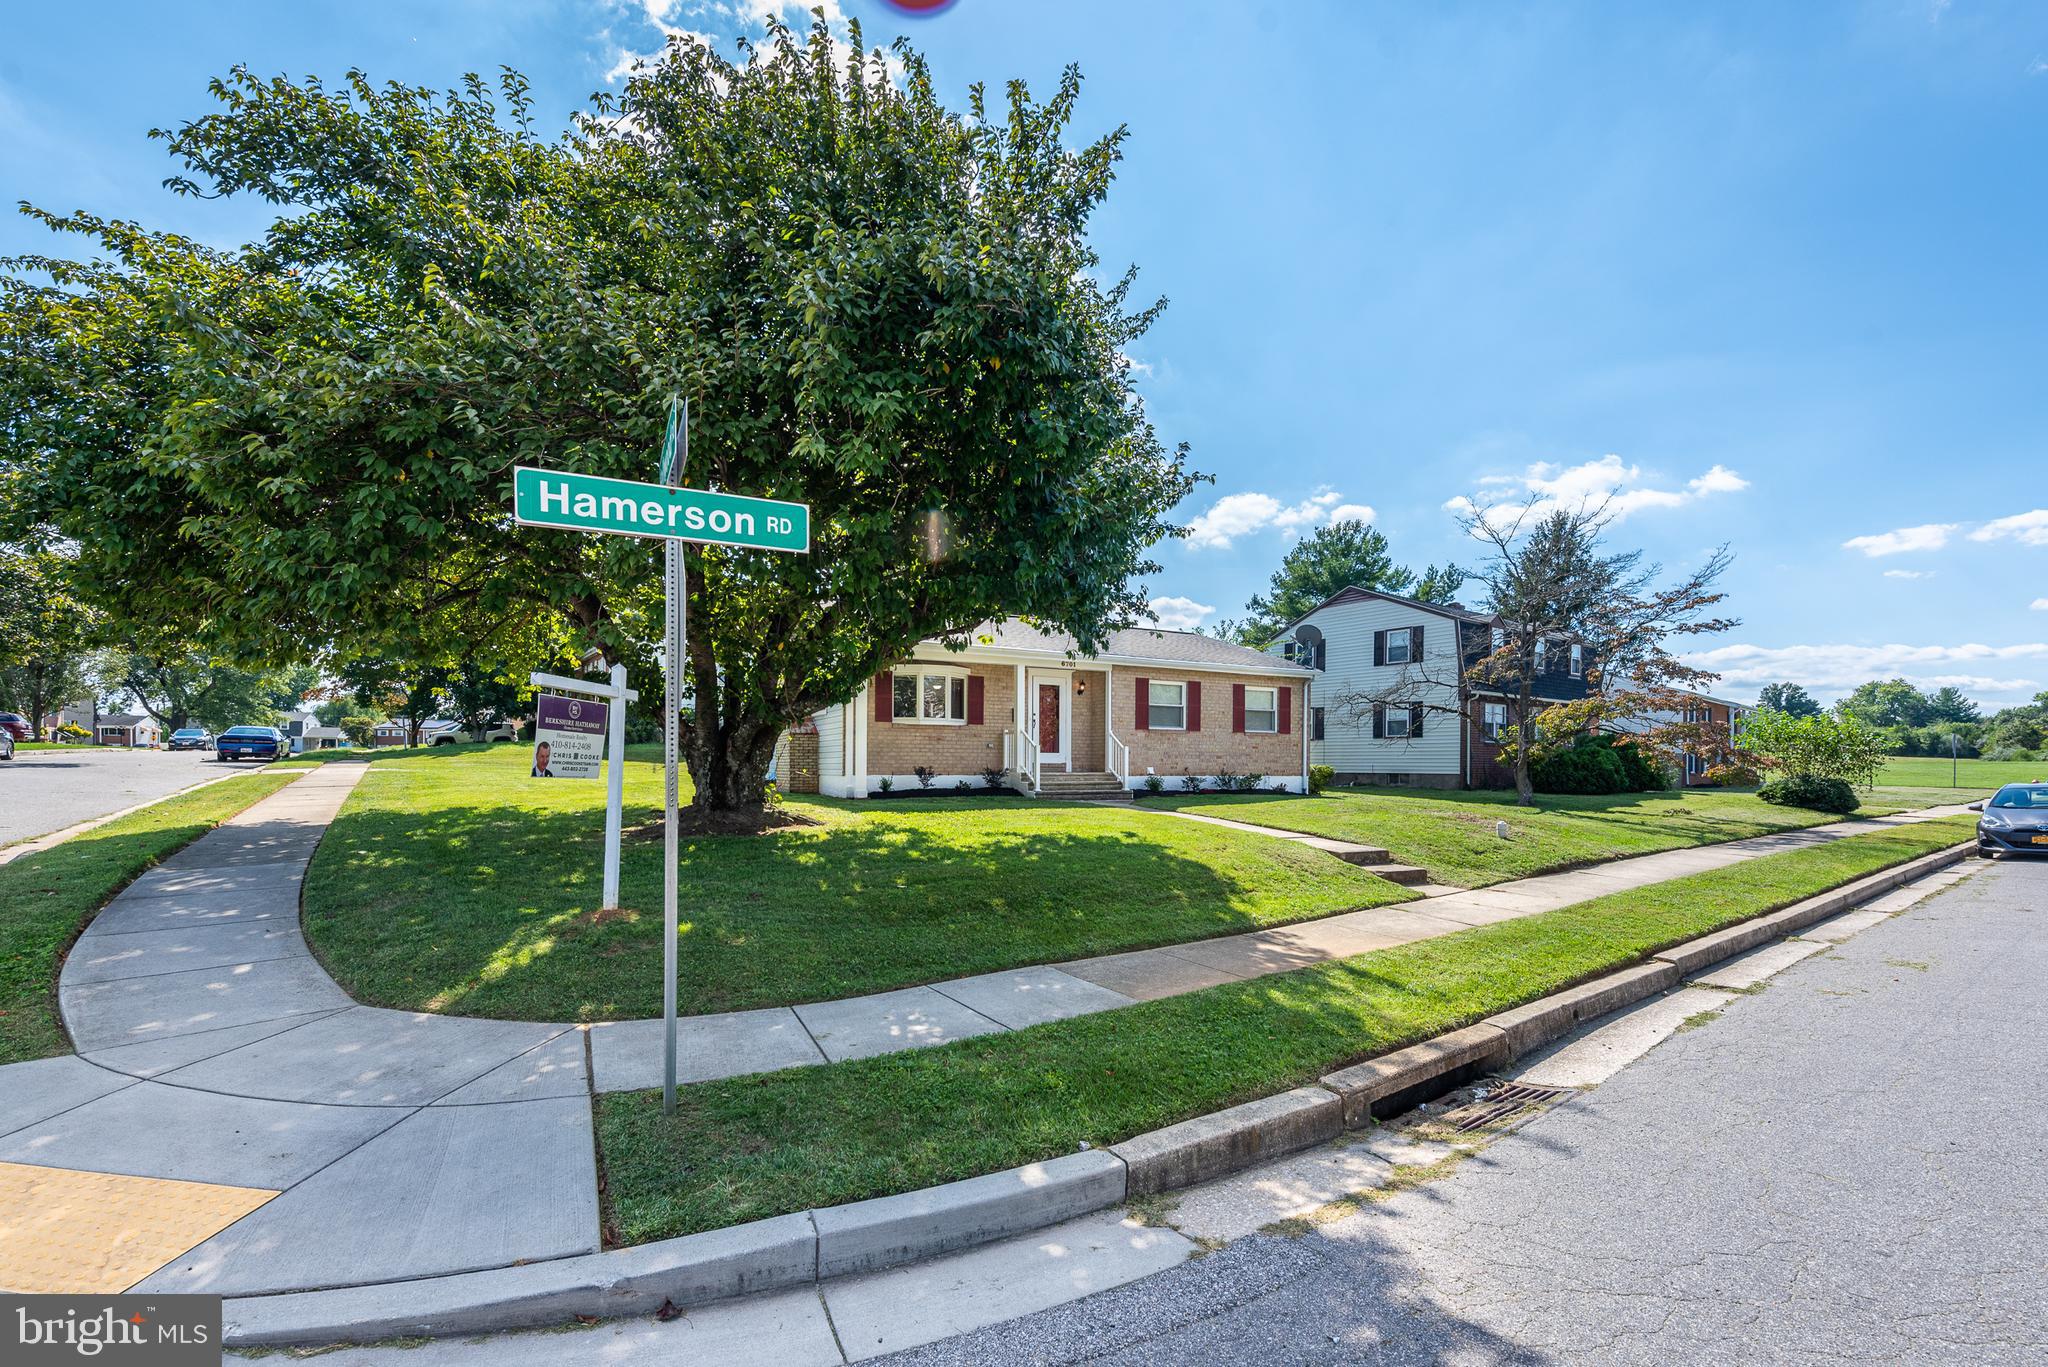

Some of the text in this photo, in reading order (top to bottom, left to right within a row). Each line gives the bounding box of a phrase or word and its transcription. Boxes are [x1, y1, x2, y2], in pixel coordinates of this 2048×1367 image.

[540, 480, 792, 536] Hamerson RD
[545, 717, 574, 726] BERKSHIRE
[575, 721, 600, 729] HATHAWAY
